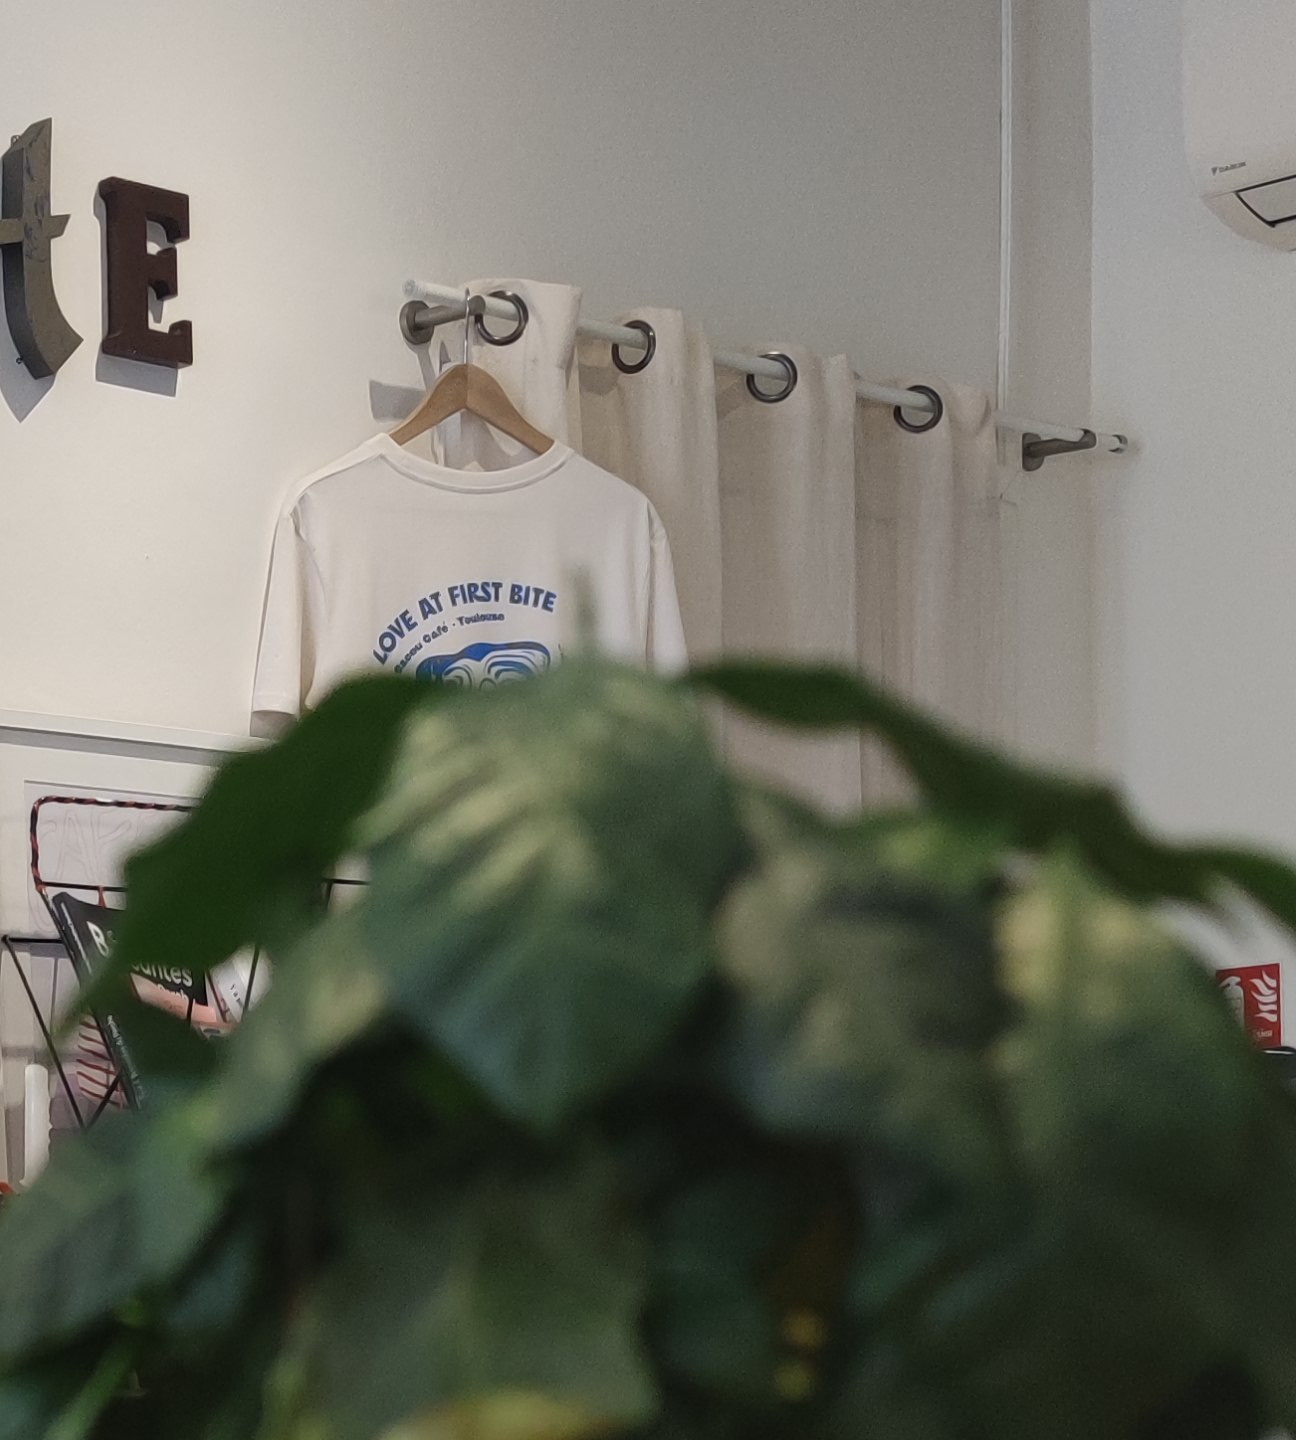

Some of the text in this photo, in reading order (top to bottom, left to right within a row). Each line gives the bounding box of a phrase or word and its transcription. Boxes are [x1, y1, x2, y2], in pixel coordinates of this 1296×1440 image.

[373, 581, 557, 665] LOVE AT FIRST BITE
[422, 621, 449, 644] Café
[456, 612, 505, 627] Toulouse
